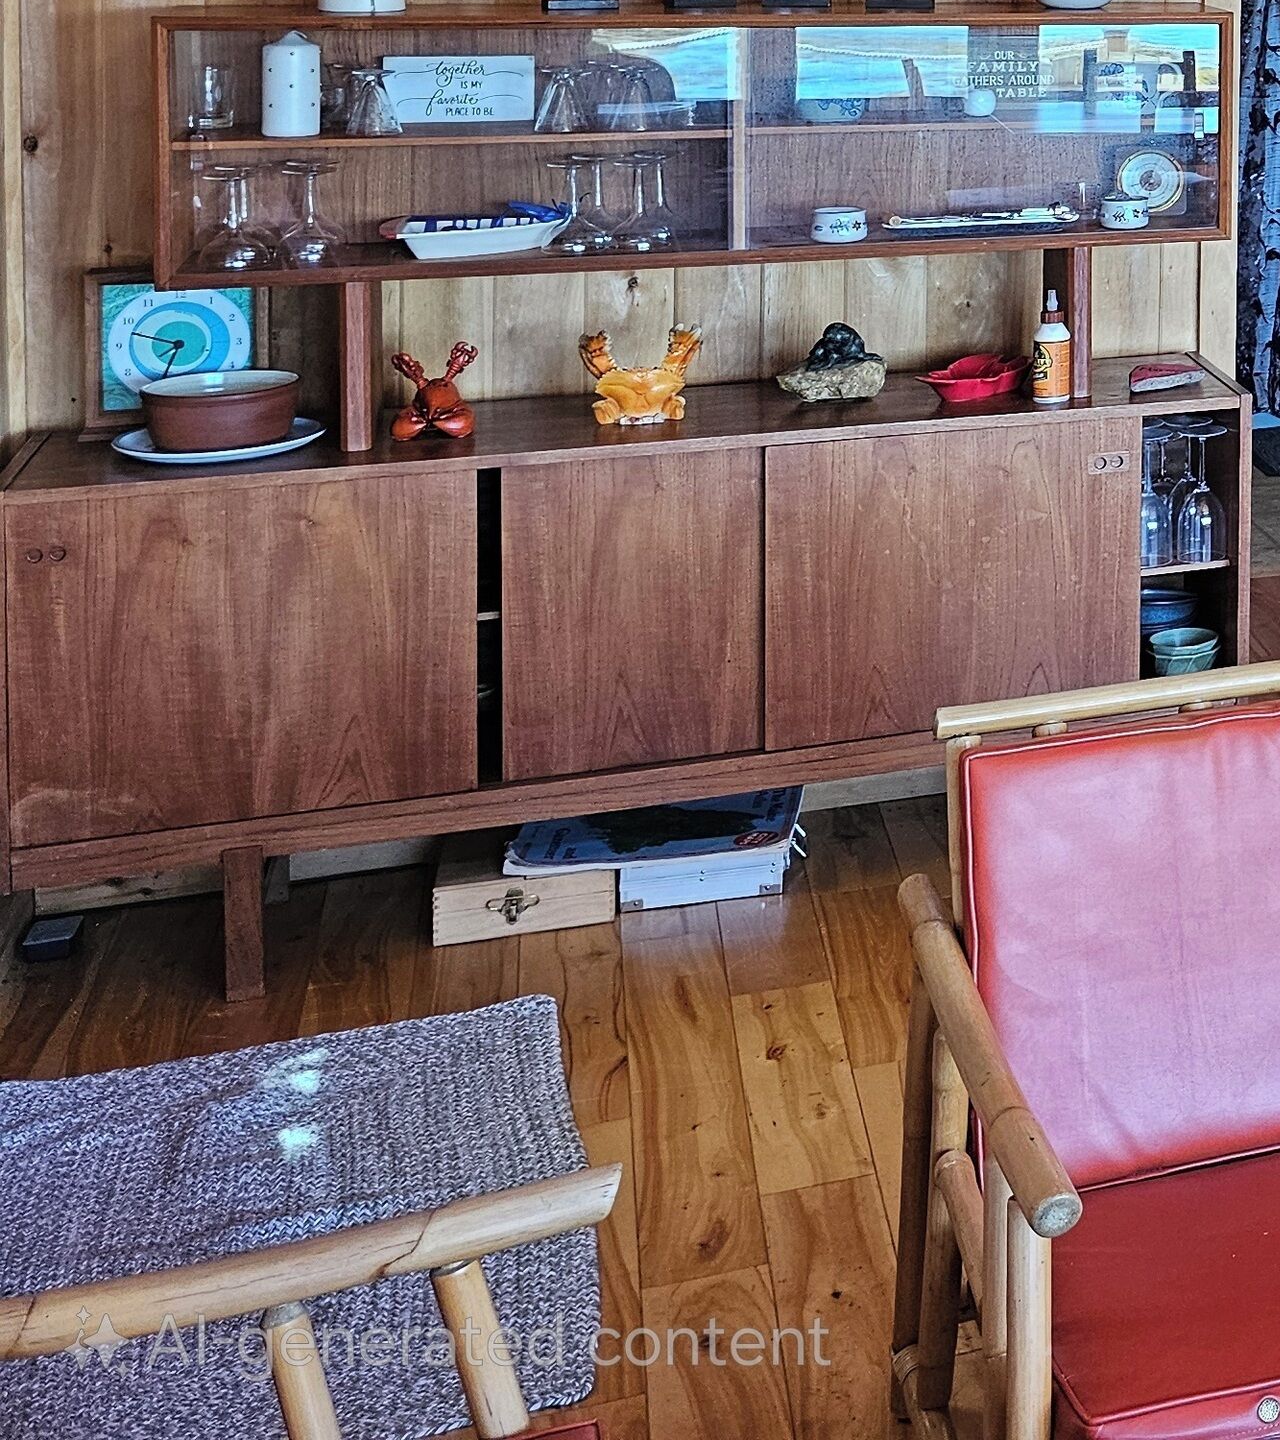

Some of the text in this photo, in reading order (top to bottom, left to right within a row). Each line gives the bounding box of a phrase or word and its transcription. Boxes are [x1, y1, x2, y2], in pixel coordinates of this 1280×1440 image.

[994, 50, 1015, 60] OUR
[968, 61, 1039, 72] FAMILY
[460, 81, 483, 89] IS MY
[1008, 75, 1055, 86] AROUND
[995, 88, 1048, 98] TABLE
[425, 88, 479, 116] favorite
[445, 106, 495, 116] PLACE TO BE
